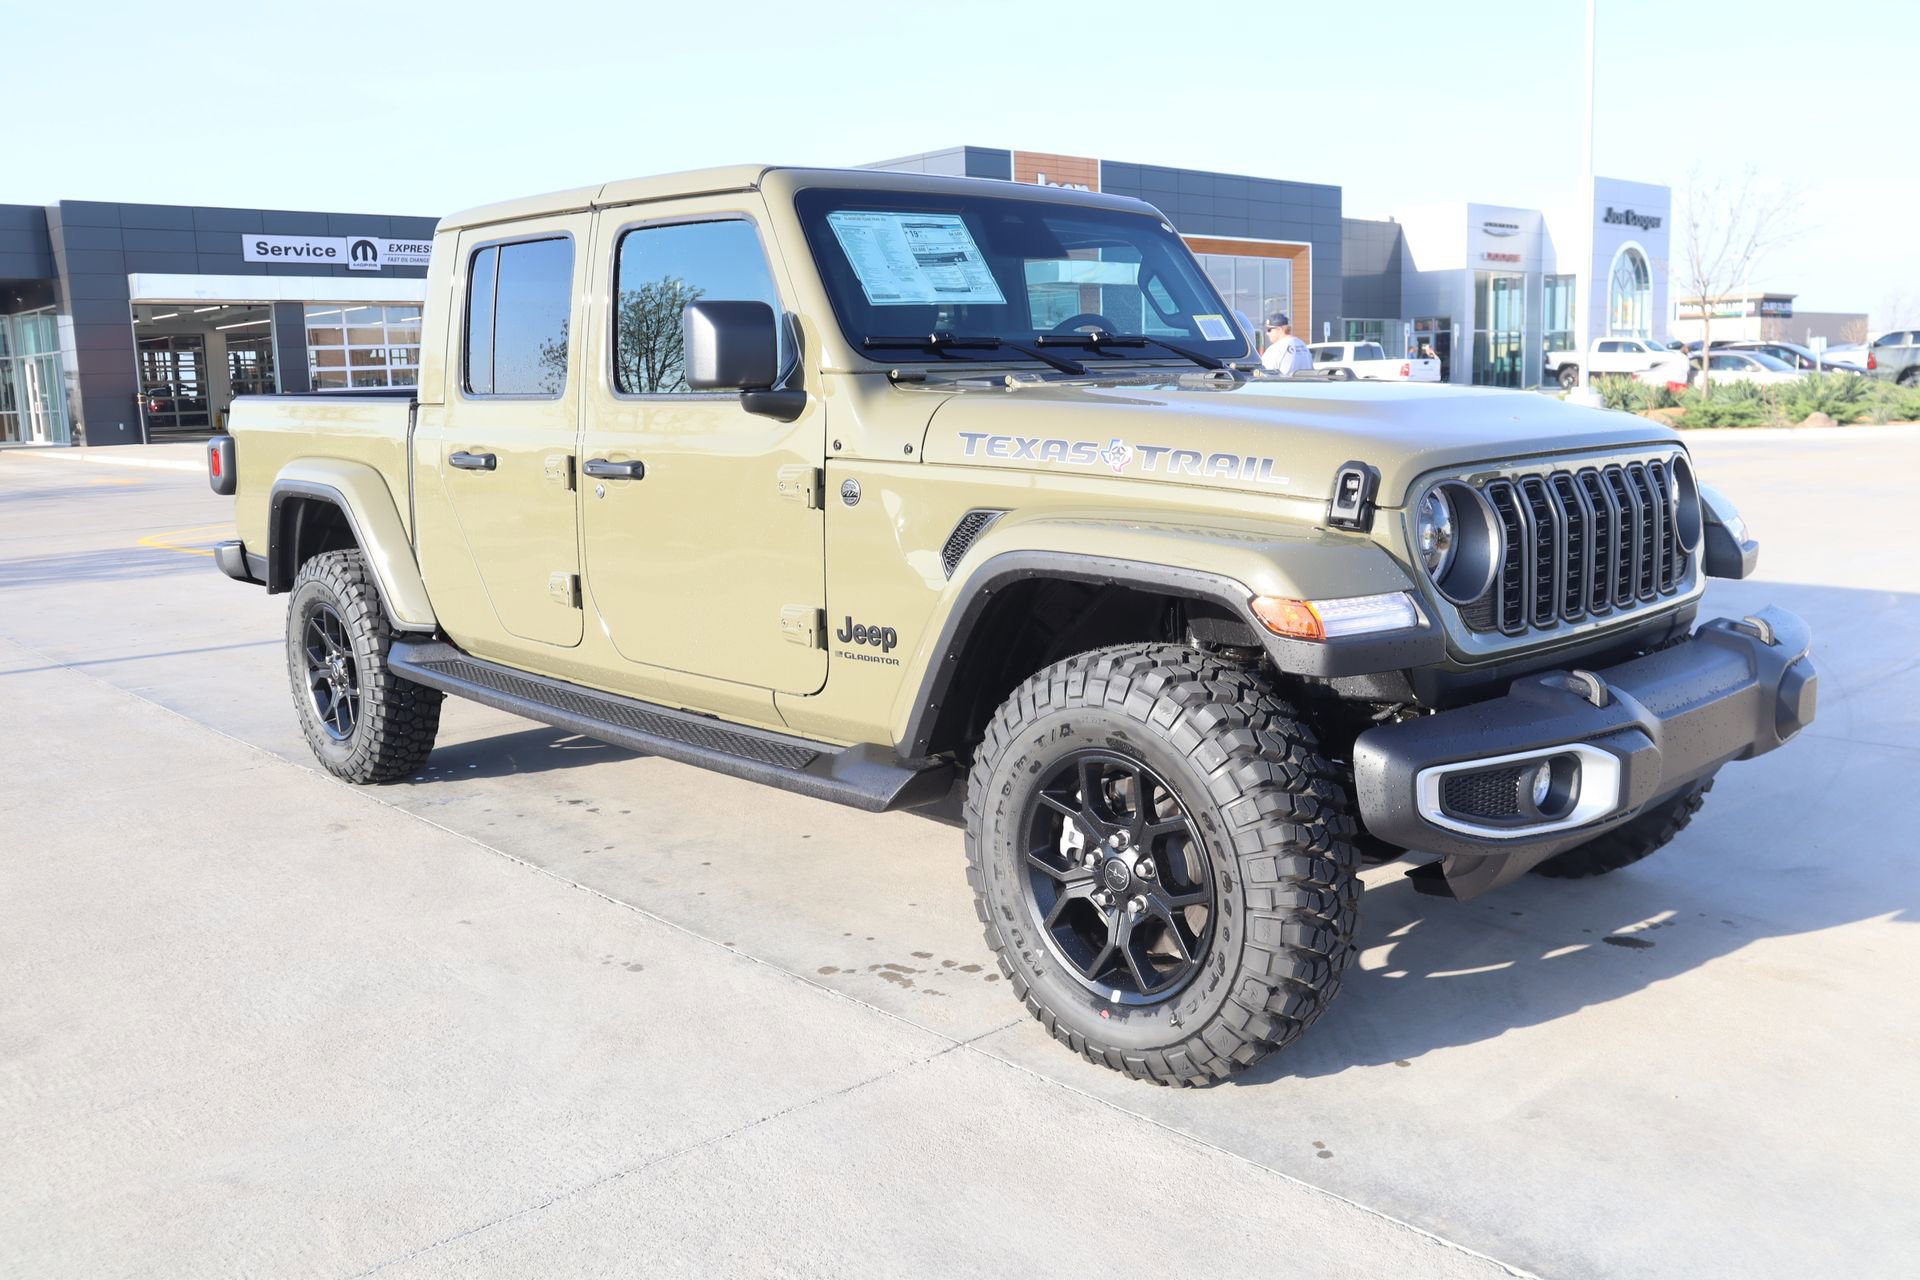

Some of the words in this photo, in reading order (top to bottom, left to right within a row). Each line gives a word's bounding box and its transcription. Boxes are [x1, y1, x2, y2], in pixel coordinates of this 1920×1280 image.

[255, 241, 337, 258] Service
[958, 431, 1100, 465] TEXAS
[1135, 444, 1291, 485] TRAIL
[836, 615, 897, 654] Jeep
[844, 651, 900, 666] GLADIATOR
